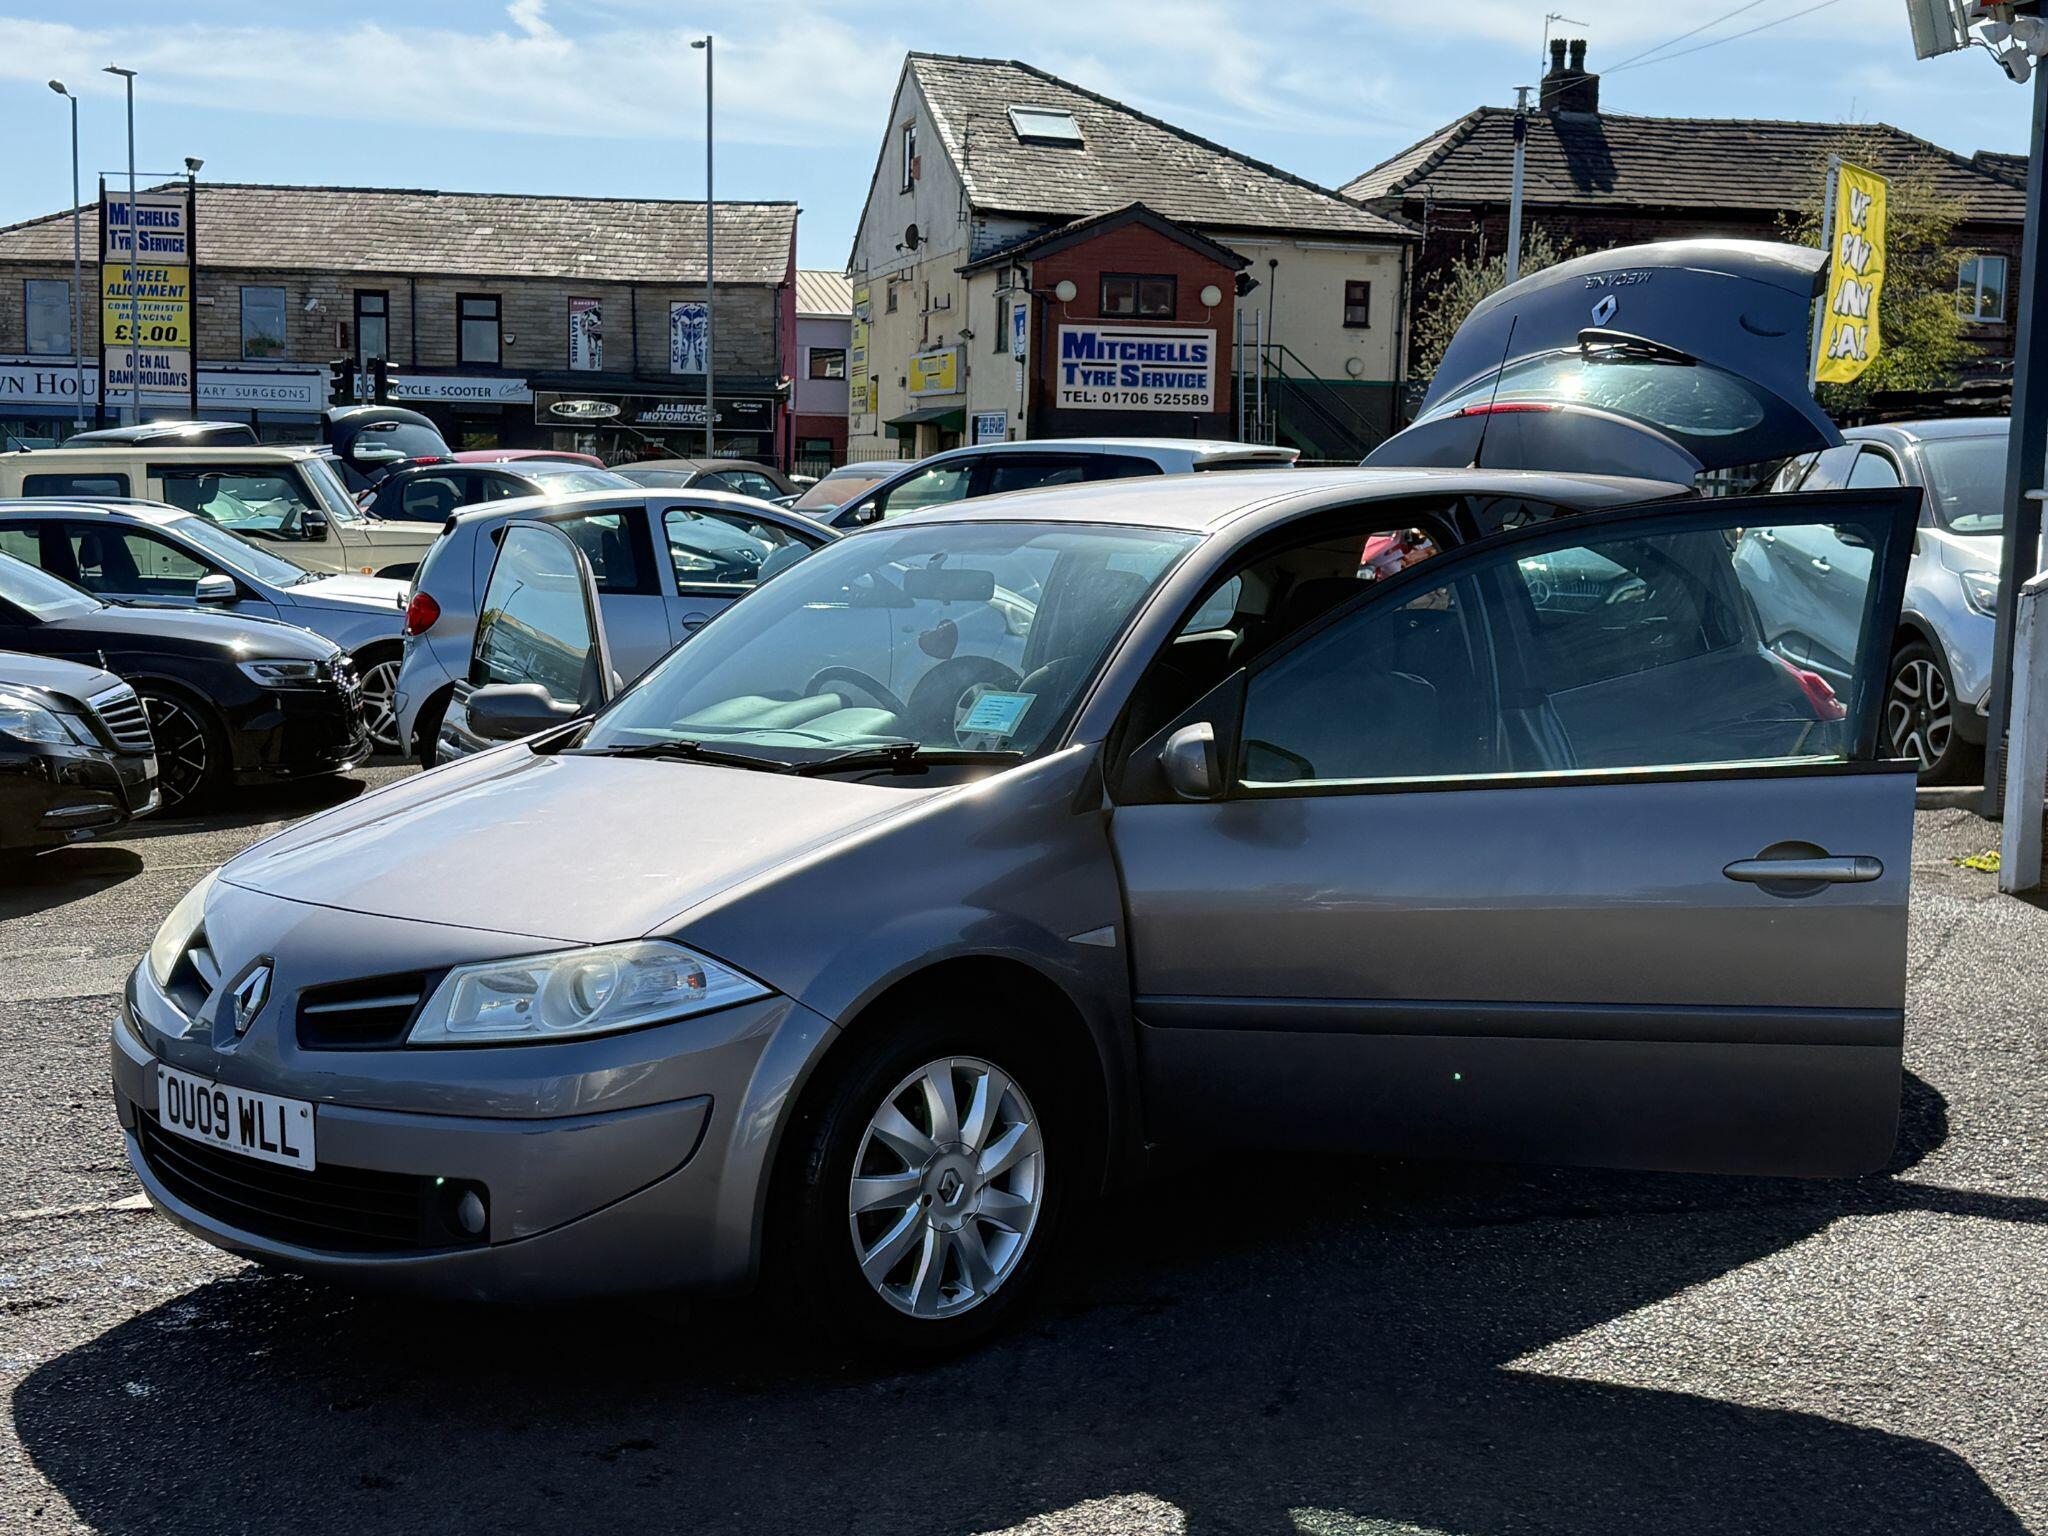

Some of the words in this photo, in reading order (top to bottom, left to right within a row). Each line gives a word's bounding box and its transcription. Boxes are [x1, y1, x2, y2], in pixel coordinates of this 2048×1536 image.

[109, 203, 179, 227] MICHELLS
[109, 230, 132, 250] TYR
[139, 231, 184, 252] SERVICE
[1063, 332, 1208, 362] MITCHELLS
[126, 354, 152, 368] OEN
[154, 355, 171, 369] ALL
[139, 371, 188, 387] HOLIDAYS
[1062, 363, 1117, 386] TYRE
[1120, 364, 1207, 389] SERVICE
[235, 387, 305, 399] SURGEONS
[440, 385, 491, 398] SCOOTER
[1063, 391, 1097, 403] TEL:
[1102, 392, 1148, 405] 01706
[1154, 393, 1209, 406] 525589
[167, 1076, 230, 1140] OU09
[238, 1096, 299, 1158] WLL
